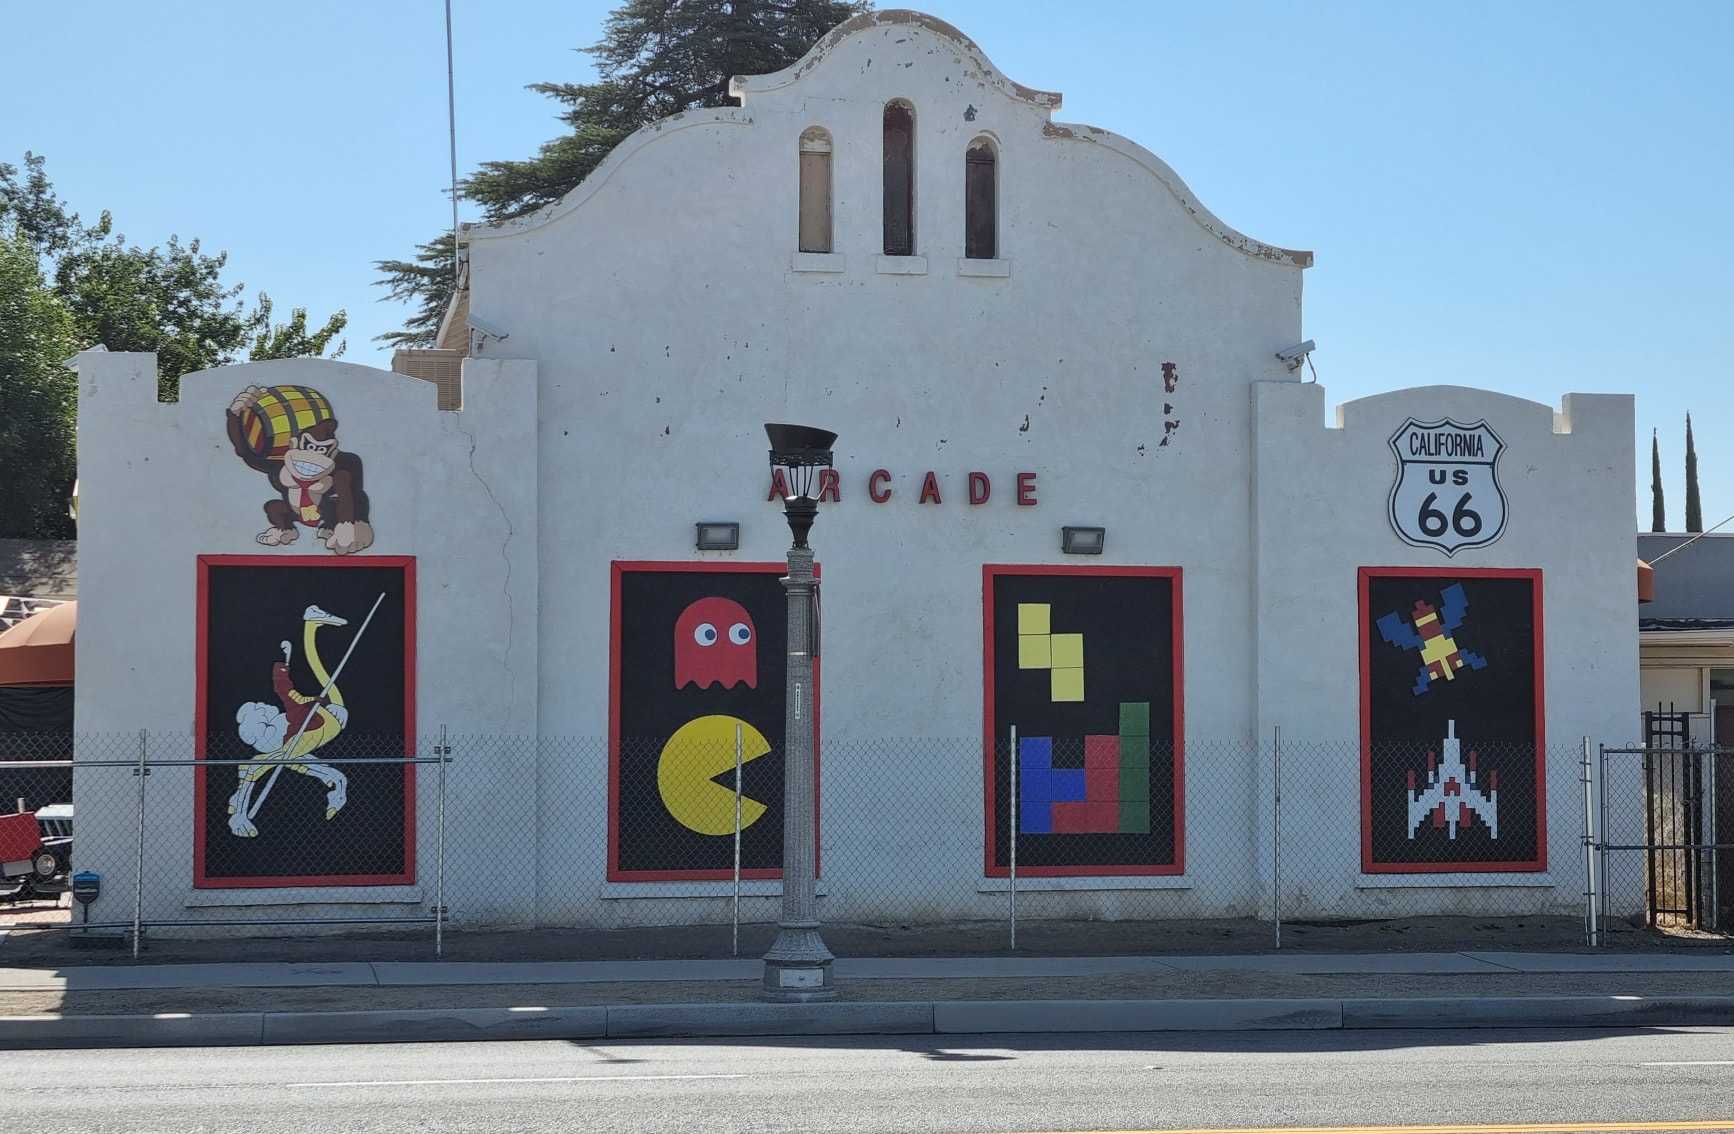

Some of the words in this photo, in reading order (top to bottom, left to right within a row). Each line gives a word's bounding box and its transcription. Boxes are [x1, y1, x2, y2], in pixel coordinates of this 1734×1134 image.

[1409, 431, 1484, 457] CALIFORNIA
[768, 468, 1037, 505] ARCADE
[1429, 468, 1468, 485] US
[1418, 492, 1482, 537] 66
